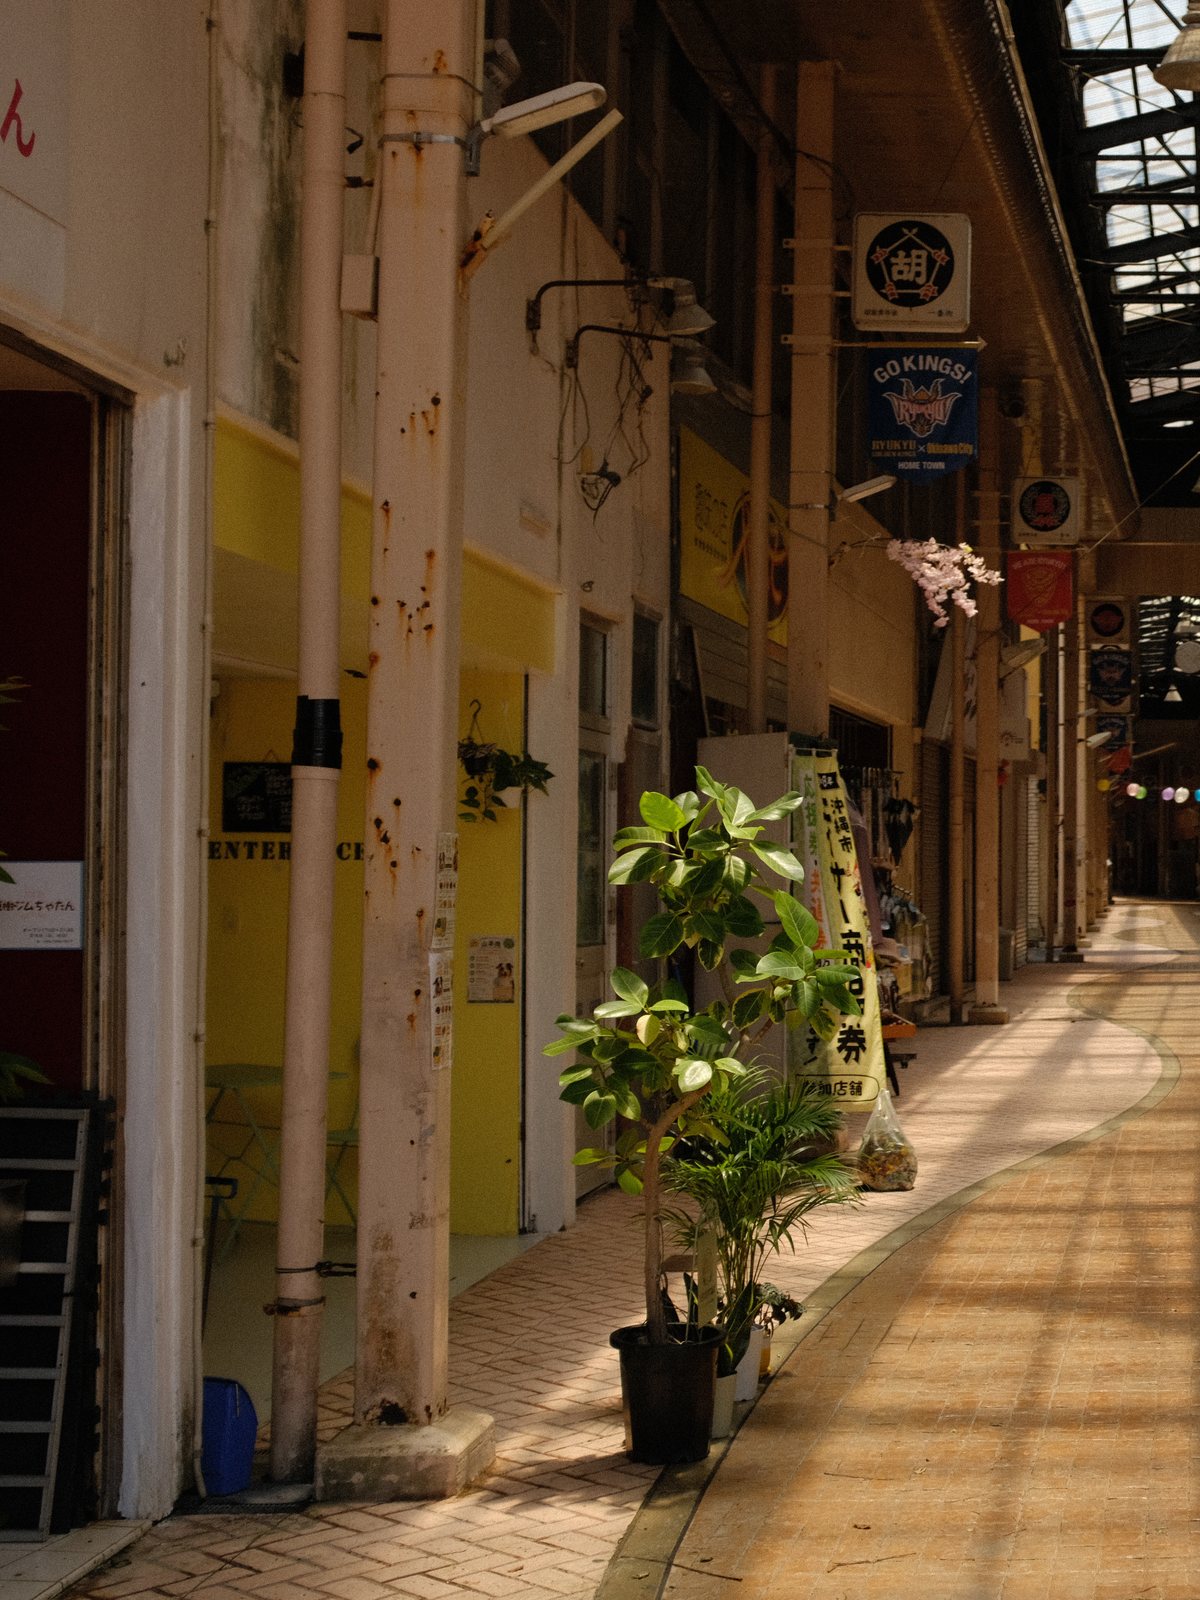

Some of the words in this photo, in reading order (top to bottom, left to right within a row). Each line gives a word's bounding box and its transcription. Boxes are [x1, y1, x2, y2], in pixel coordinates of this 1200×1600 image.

[0, 78, 35, 158] ん
[889, 249, 928, 285] 胡
[873, 359, 901, 384] GO
[902, 354, 973, 385] KINGS!
[831, 796, 853, 854] 沖縄市
[208, 841, 365, 861] ENTERCE
